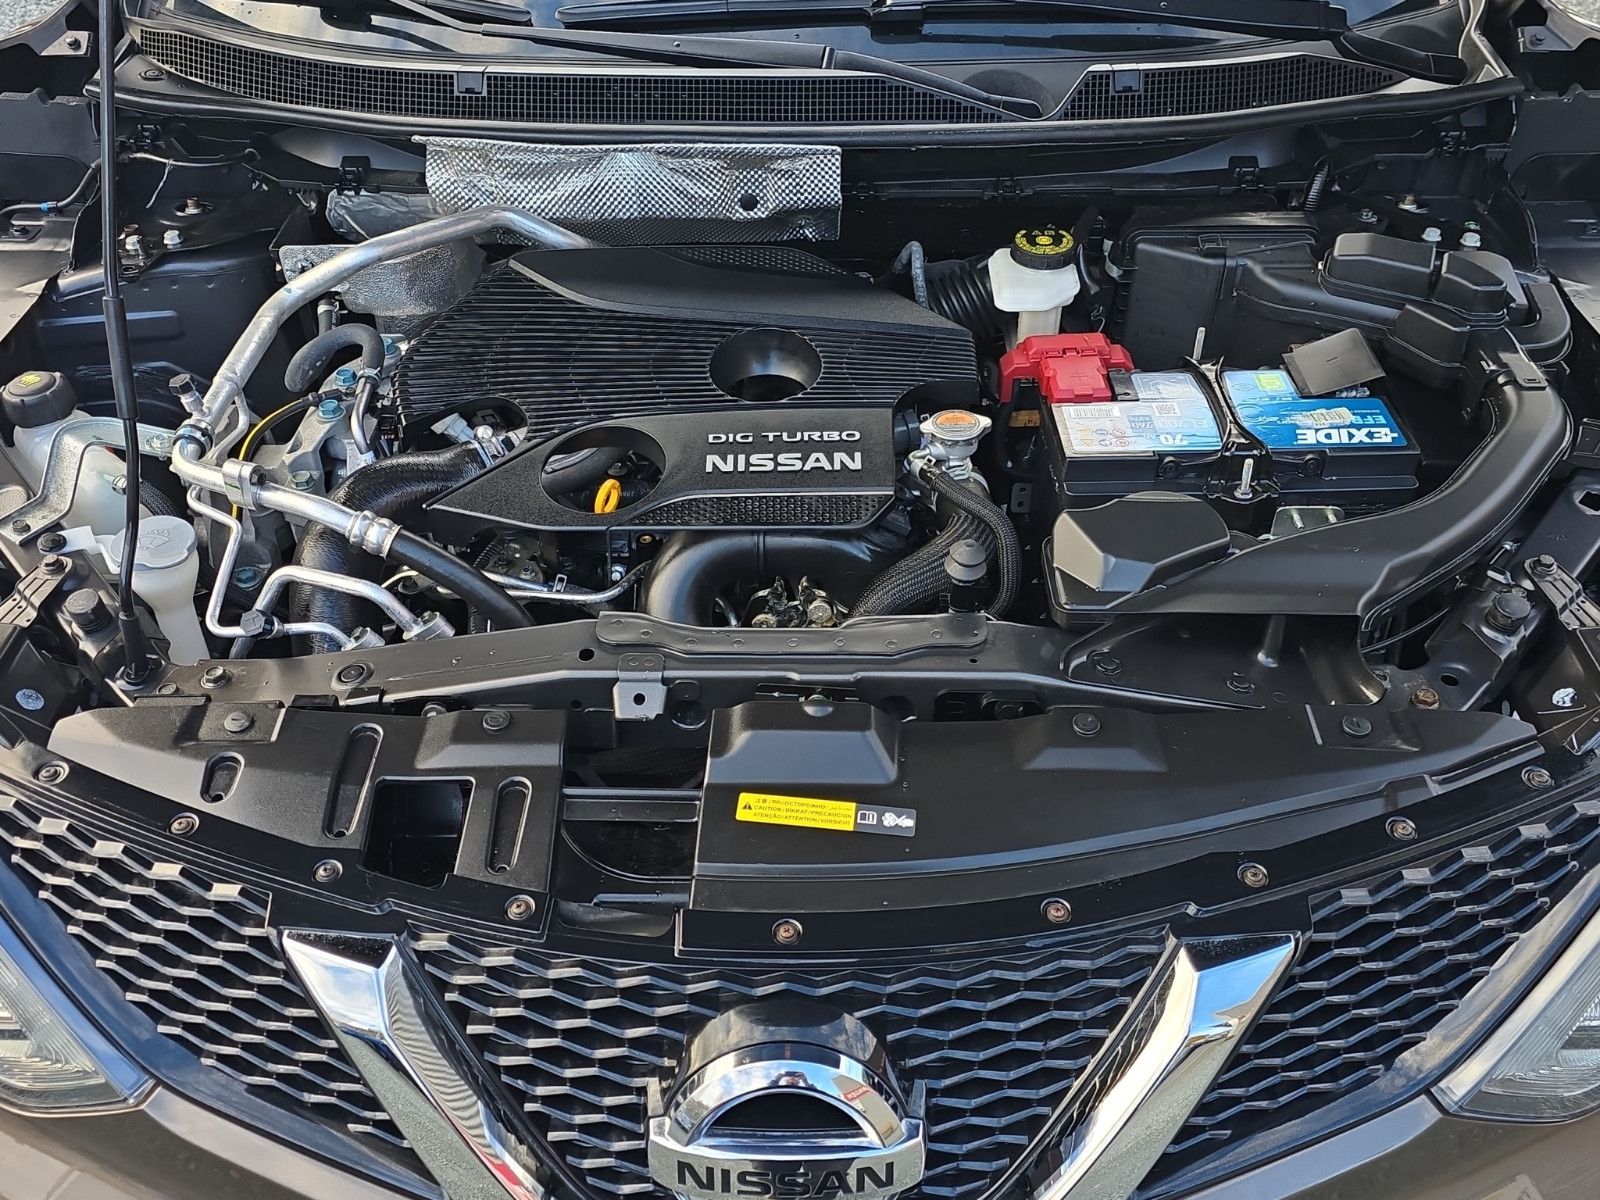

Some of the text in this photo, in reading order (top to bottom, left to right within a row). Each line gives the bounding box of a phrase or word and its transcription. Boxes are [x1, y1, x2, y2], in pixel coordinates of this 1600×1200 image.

[708, 430, 861, 443] DIG TURBO
[1159, 433, 1189, 445] 70
[1295, 427, 1399, 444] EXIDE
[705, 451, 862, 473] NISSAN
[754, 804, 782, 812] CAUTION
[677, 1160, 895, 1199] NISSAN
